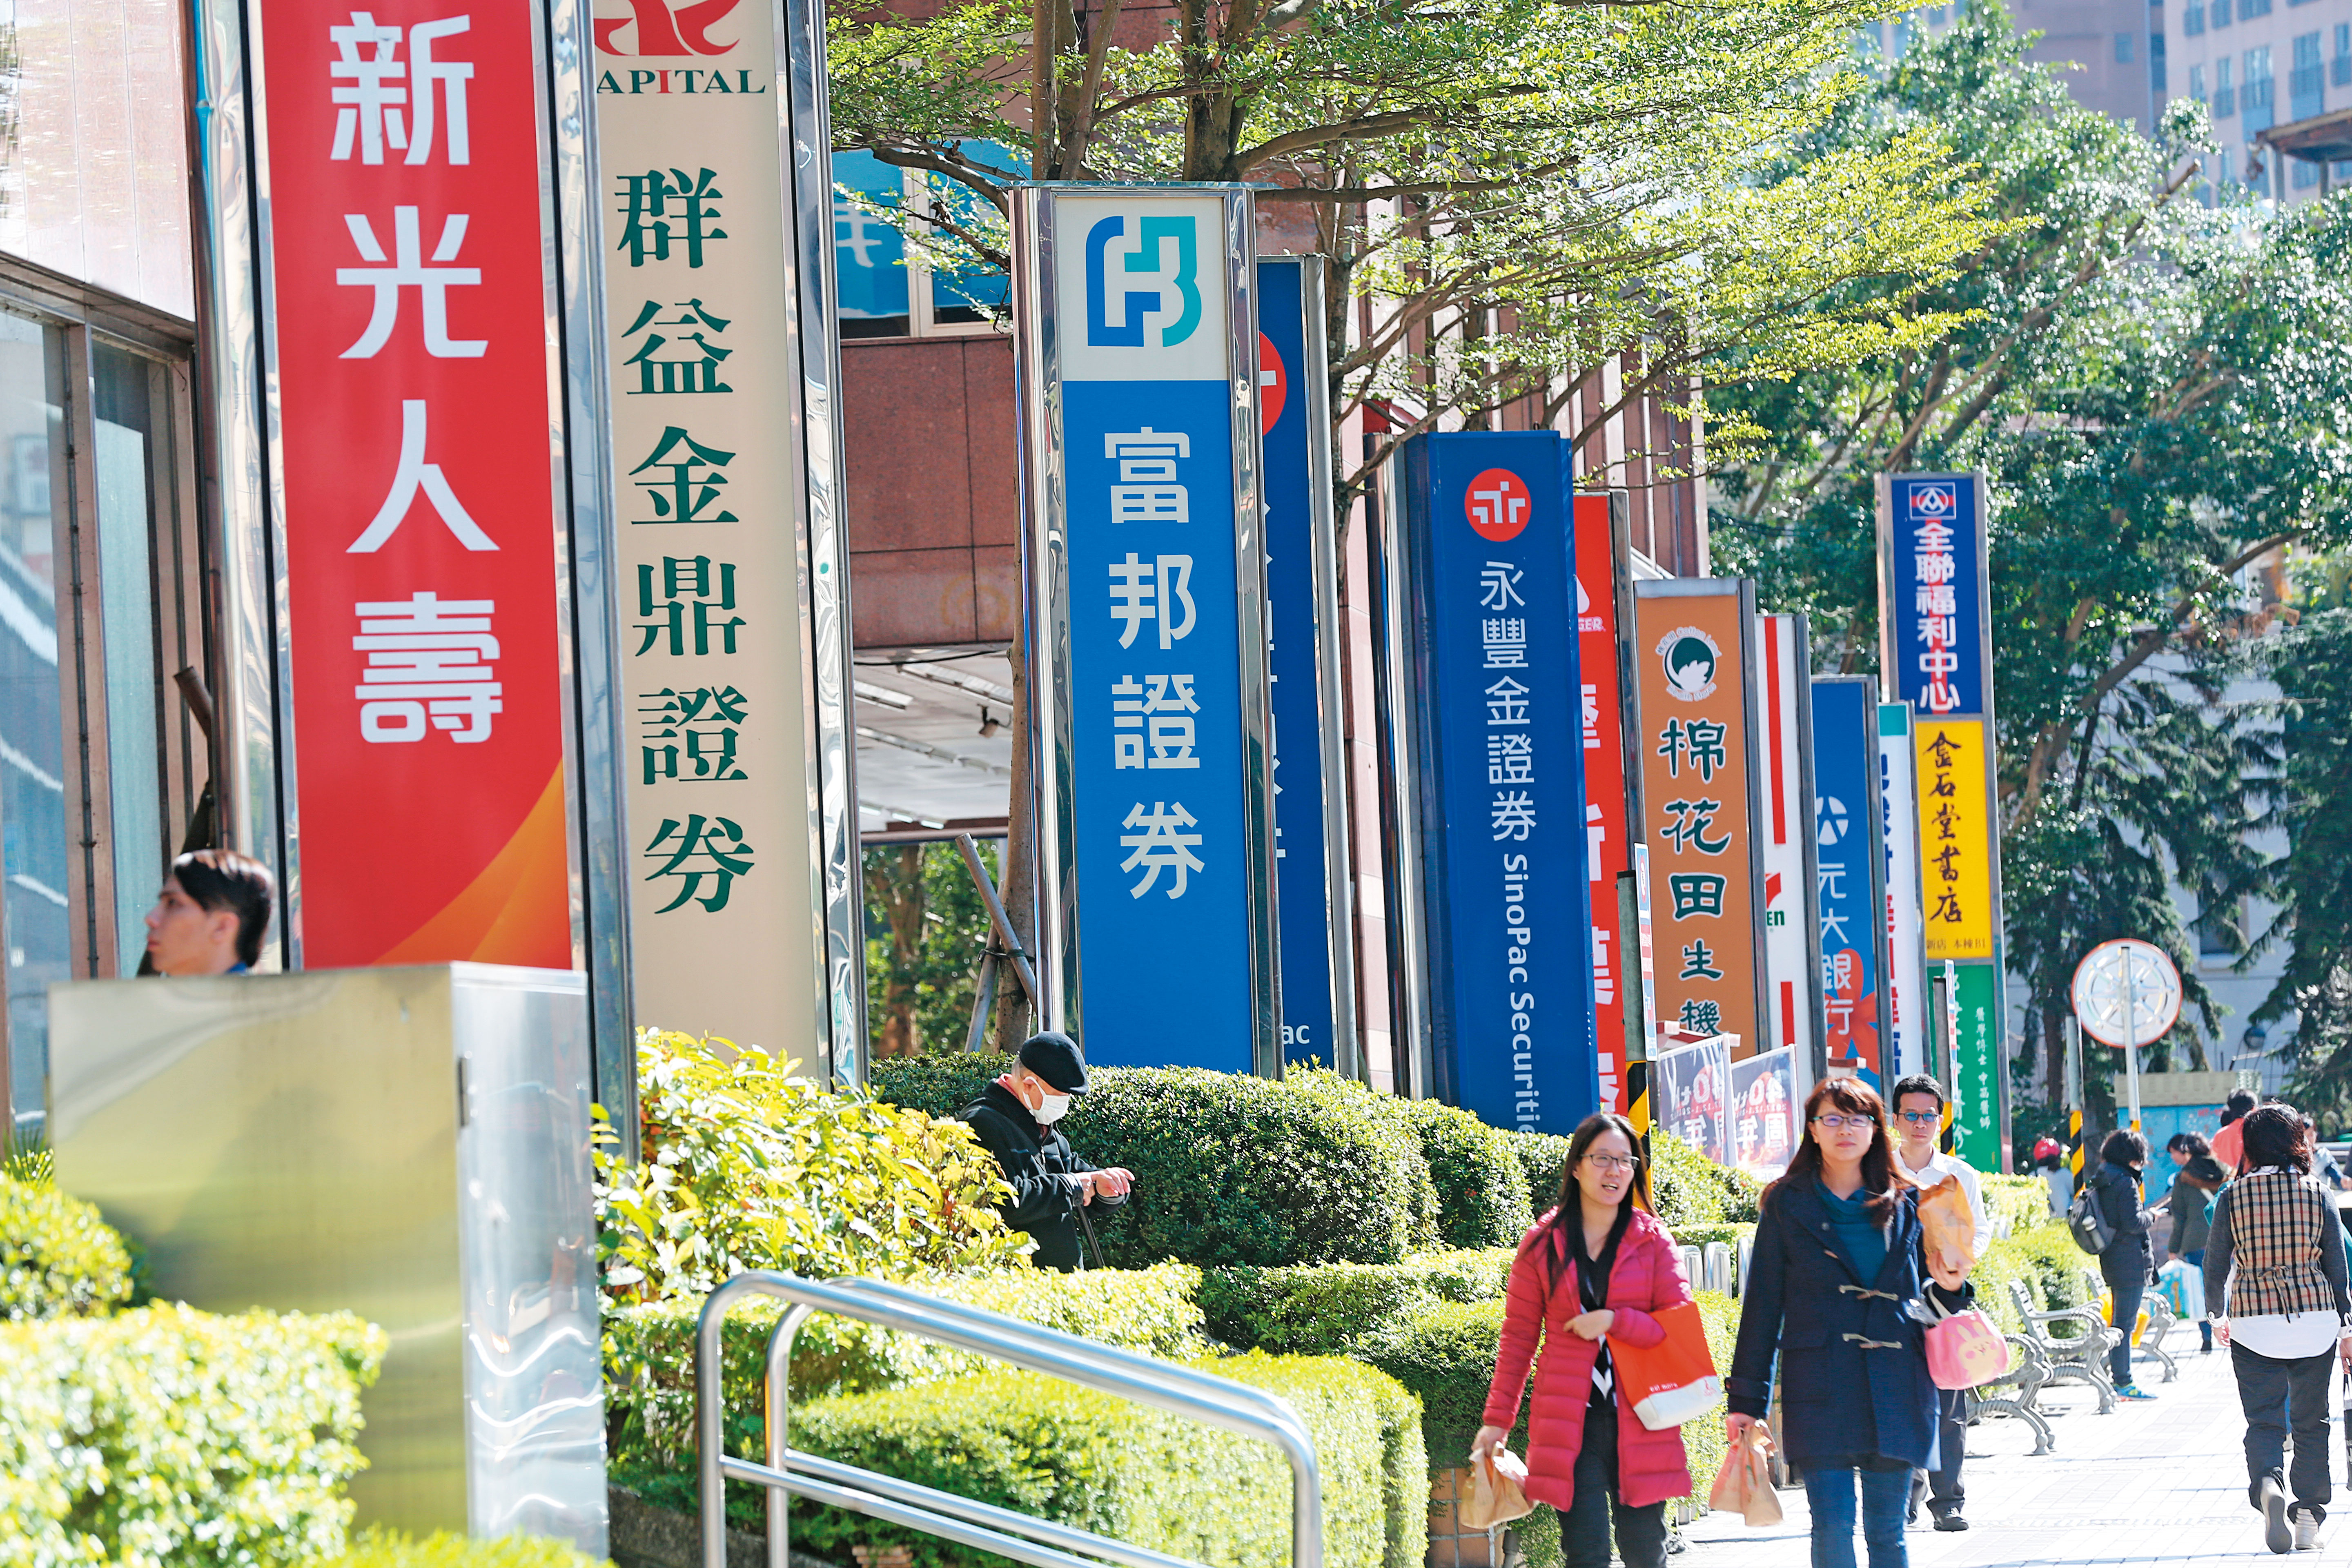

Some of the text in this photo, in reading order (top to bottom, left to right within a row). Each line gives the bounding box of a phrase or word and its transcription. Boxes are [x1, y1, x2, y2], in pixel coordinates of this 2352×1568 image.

[330, 11, 503, 743] 新光人壽
[614, 167, 755, 914] 群益金鼎證券
[1104, 426, 1205, 900] 富邦證券
[1913, 522, 1961, 711] 全聯福利中心
[1480, 561, 1537, 842] 永豐金證券
[1922, 730, 1962, 922] 金石堂書店
[1503, 853, 1531, 983] SinoPac
[1657, 716, 1732, 1036] 棉花田生機
[1818, 862, 1854, 1036] 元大銀行
